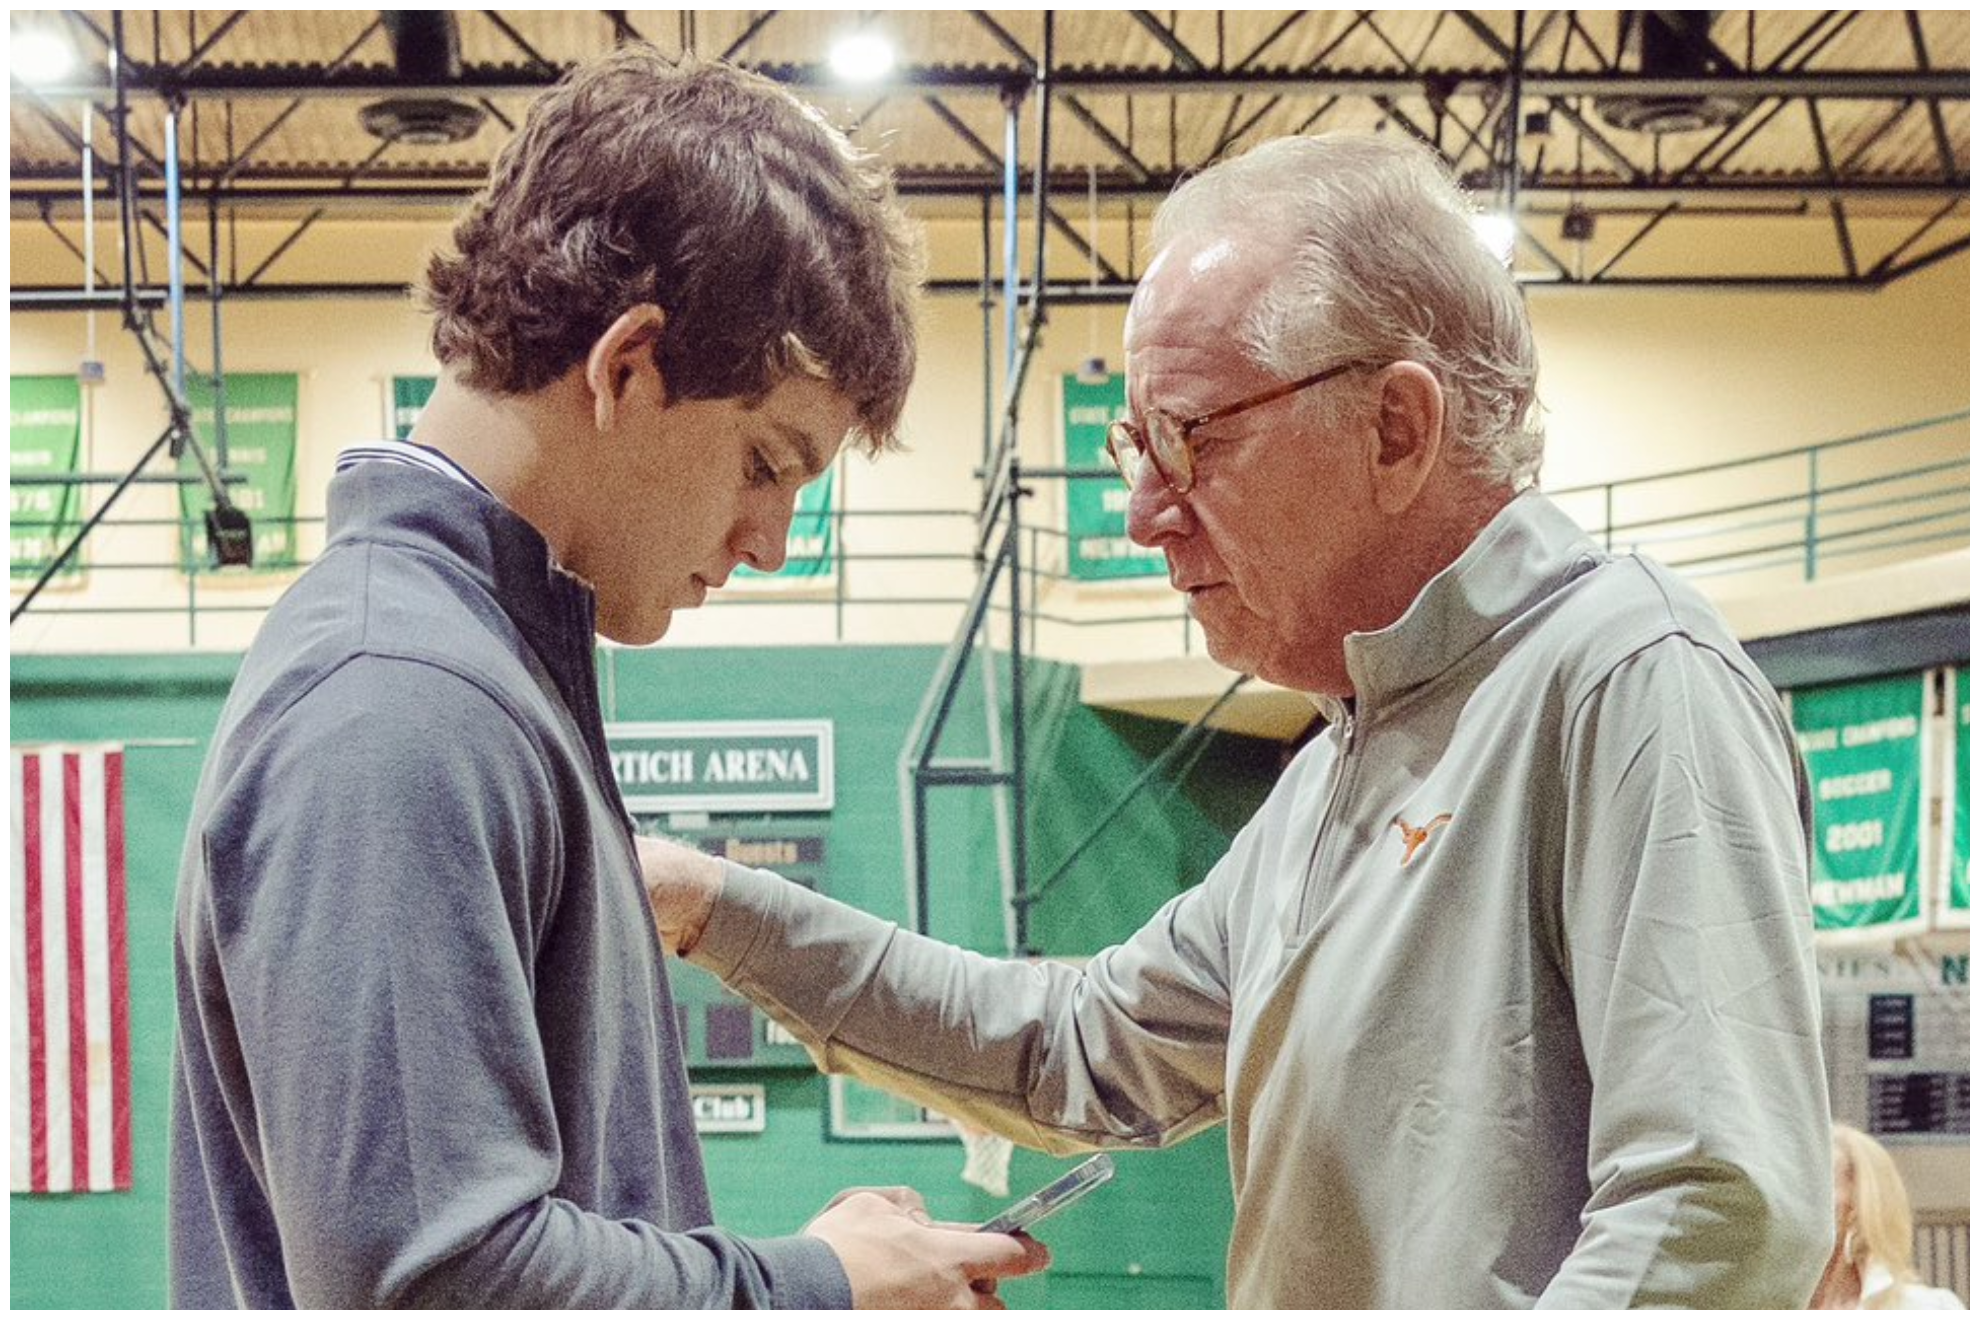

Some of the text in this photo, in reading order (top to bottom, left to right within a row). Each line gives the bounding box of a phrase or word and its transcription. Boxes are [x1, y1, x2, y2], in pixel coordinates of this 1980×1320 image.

[702, 748, 810, 783] ARENA
[1825, 818, 1884, 854] 2001
[692, 1096, 751, 1119] Club
